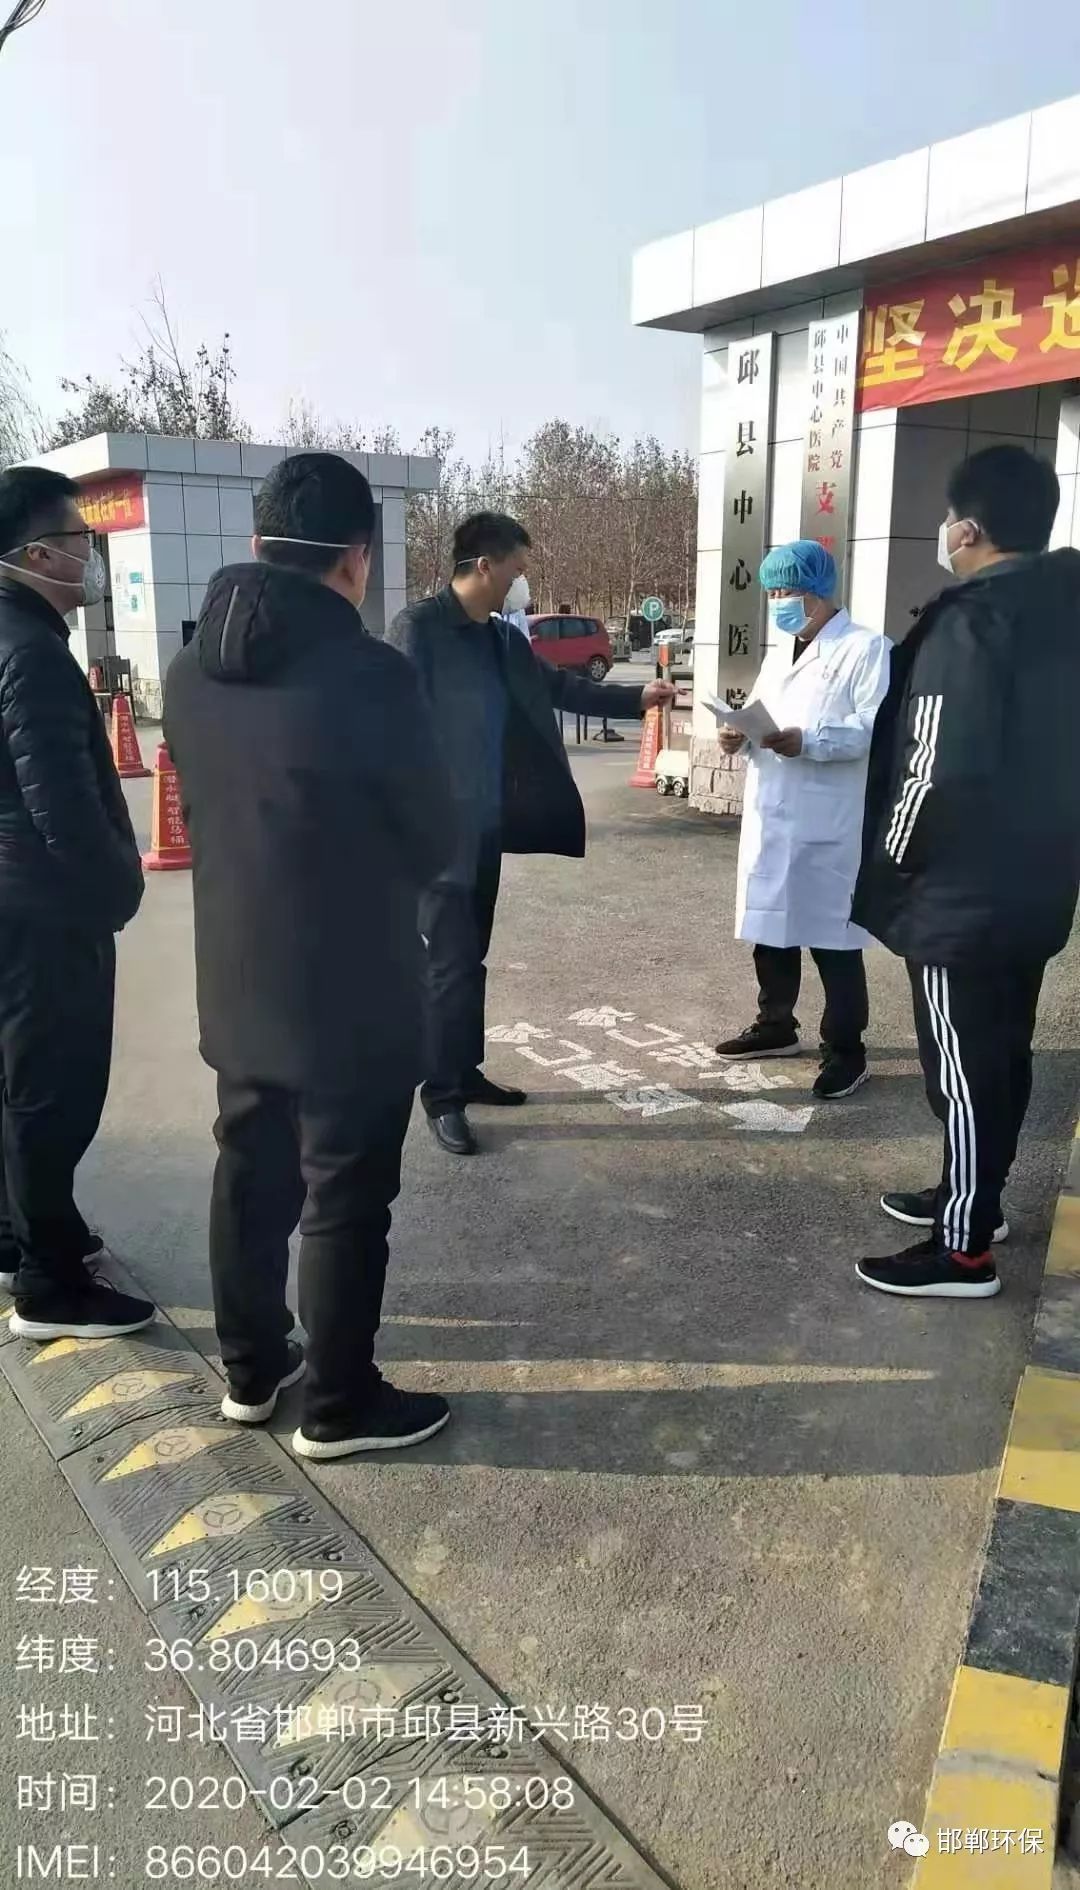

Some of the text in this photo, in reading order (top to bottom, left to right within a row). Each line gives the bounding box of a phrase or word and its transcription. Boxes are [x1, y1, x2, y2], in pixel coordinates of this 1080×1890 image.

[807, 329, 828, 473] 邱县中心医院
[829, 323, 850, 469] 中国共产党
[649, 601, 660, 617] P
